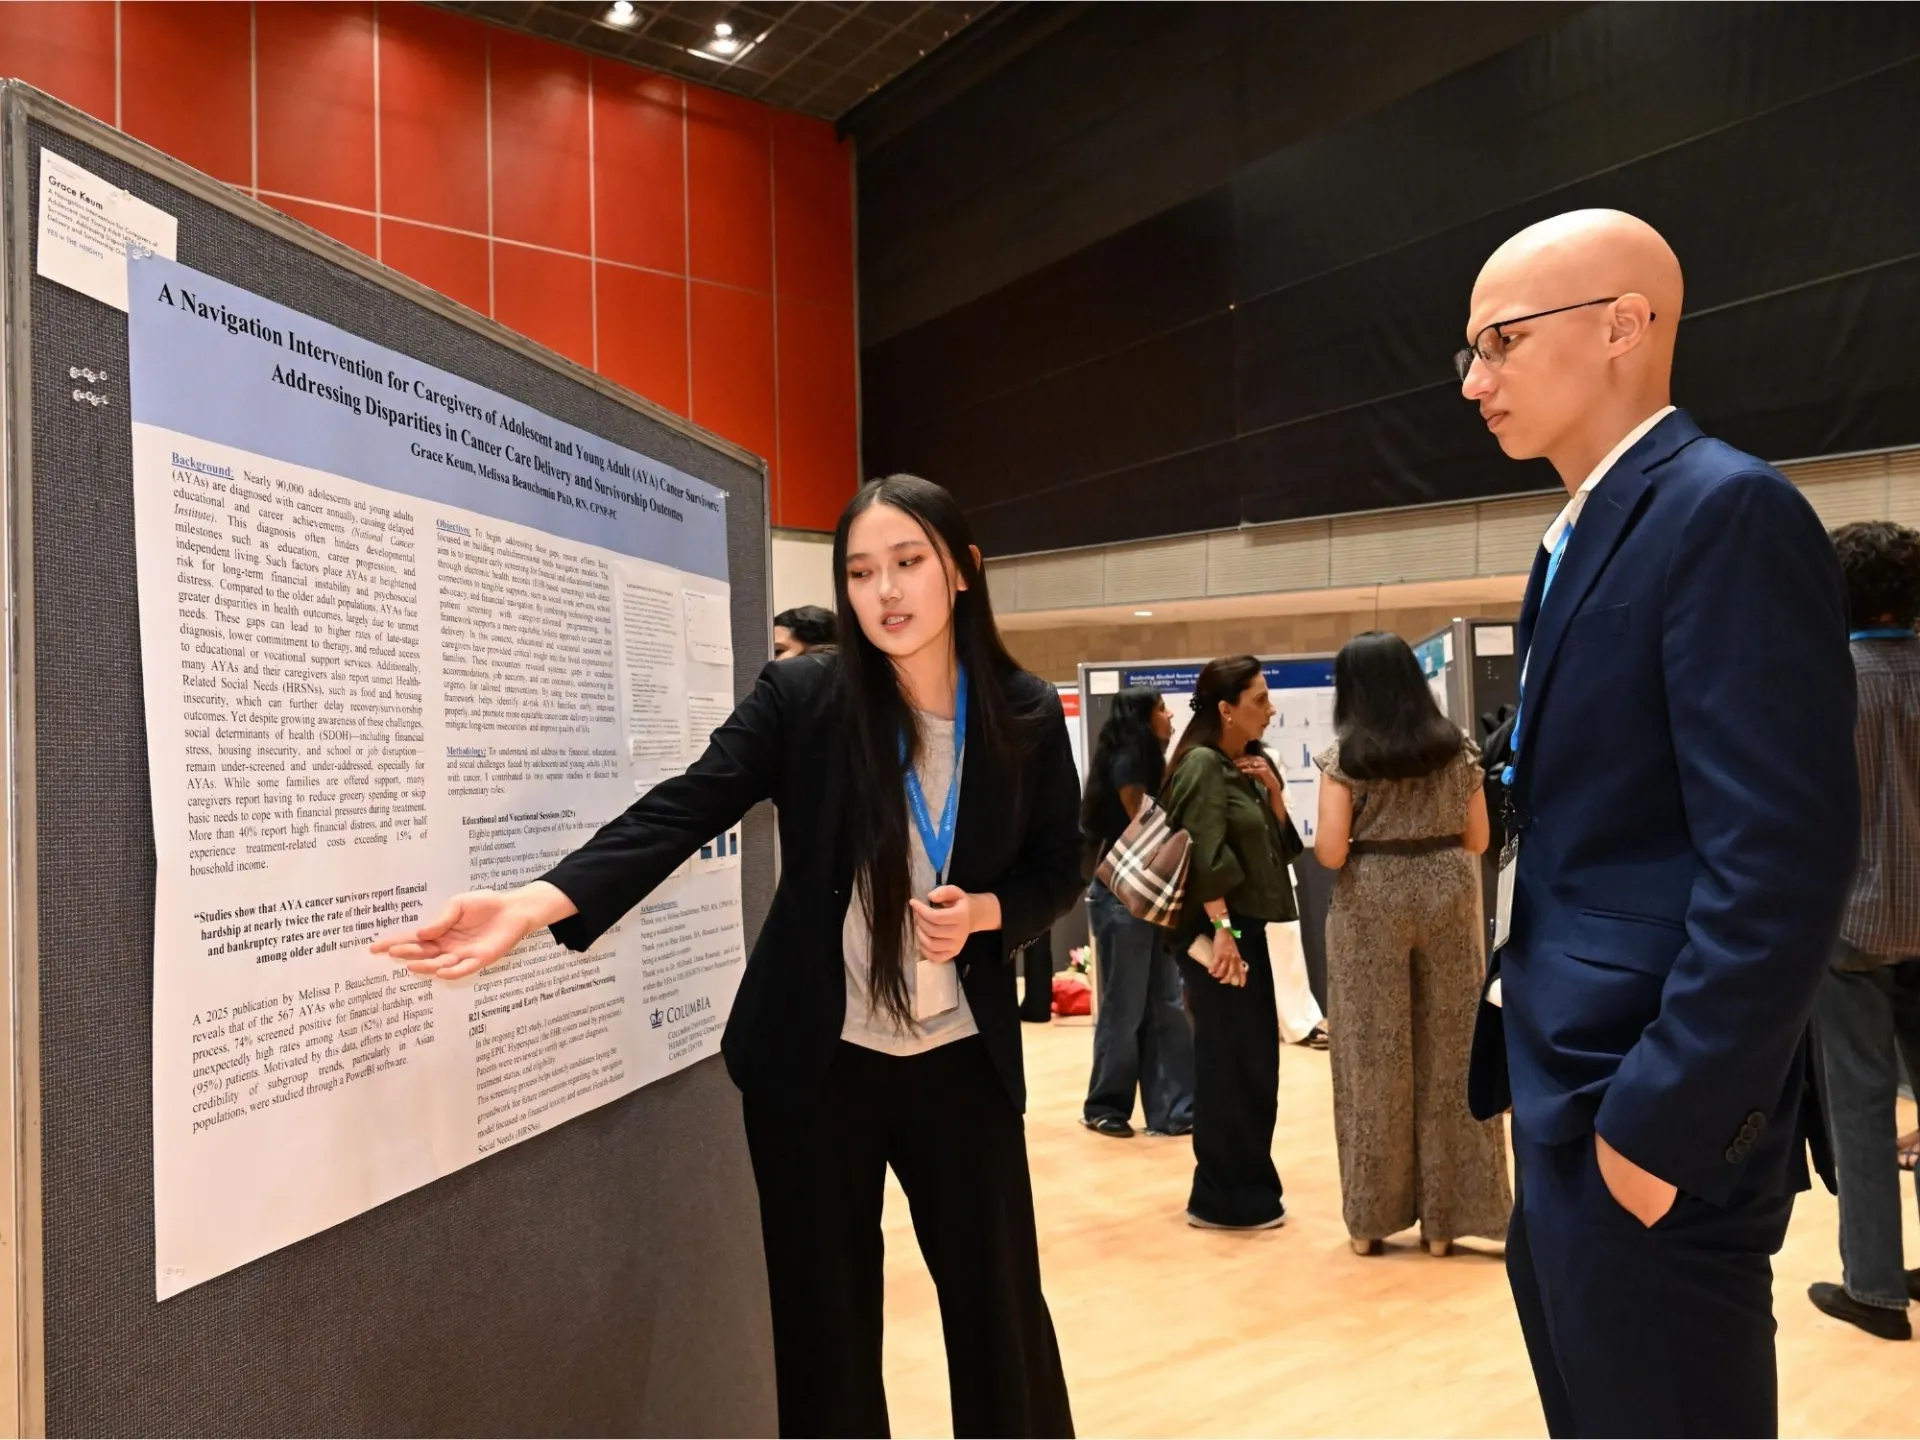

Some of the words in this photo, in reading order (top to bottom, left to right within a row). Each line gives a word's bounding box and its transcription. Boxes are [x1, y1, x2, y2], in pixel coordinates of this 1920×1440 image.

[49, 175, 76, 196] Grace
[80, 191, 103, 210] Keum
[47, 214, 70, 230] Delivery
[72, 227, 82, 236] and
[76, 220, 104, 239] Addressing
[80, 214, 89, 222] and
[91, 218, 106, 232] Young
[125, 226, 151, 245] Caregivers
[66, 236, 77, 248] THE
[79, 243, 104, 260] HEIGHTS
[158, 282, 175, 306] A
[180, 289, 282, 347] Navigation
[288, 331, 382, 384] Intervention
[388, 371, 409, 393] for
[414, 381, 482, 420] Caregivers
[486, 411, 496, 425] of
[500, 414, 552, 448] Adolescent
[555, 441, 572, 456] and
[576, 444, 604, 472] Young
[607, 460, 630, 478] Adult
[632, 469, 658, 488] (AYA)
[660, 478, 684, 498] Cancer
[686, 489, 719, 512] Survivors:
[272, 364, 361, 415] Addressing
[365, 395, 442, 437] Disparities
[445, 423, 457, 442] in
[462, 429, 501, 457] Cancer
[505, 444, 532, 468] Care
[534, 455, 571, 486] Delivery
[575, 473, 592, 489] and
[595, 478, 648, 512] Survivorship
[650, 499, 683, 522] Outcomes
[172, 452, 234, 479] Background:
[244, 470, 271, 489] Nearly
[276, 479, 304, 494] 90,000
[309, 488, 351, 506] adolescents
[354, 501, 366, 510] and
[369, 505, 390, 519] young
[393, 510, 414, 521] adults
[411, 442, 443, 463] Grace
[446, 452, 476, 476] Keum,
[478, 463, 510, 488] Melissa
[512, 476, 556, 501] Beauchemin
[557, 491, 573, 508] PhD,
[576, 498, 589, 511] RN,
[590, 502, 617, 520] CPNP-PC
[172, 470, 209, 490] (AYAs)
[213, 482, 226, 492] are
[230, 484, 272, 502] diagnosed
[275, 496, 294, 508] with
[297, 501, 323, 514] cancer
[327, 508, 358, 524] annually,
[361, 517, 385, 531] causing
[388, 522, 414, 536] delayed
[174, 488, 225, 508] educational
[235, 503, 250, 513] and
[259, 509, 284, 520] career
[292, 515, 345, 533] achievements
[351, 527, 383, 543] (National
[390, 536, 415, 549] Cancer
[446, 746, 486, 758] Methodology:
[462, 815, 496, 825] Educational
[498, 814, 508, 823] and
[510, 812, 538, 822] Vocational
[540, 811, 559, 819] Sessions
[190, 861, 234, 876] household
[236, 860, 268, 871] income.
[194, 909, 232, 923] “Studies
[235, 907, 255, 918] show
[258, 903, 276, 914] that
[280, 899, 302, 911] AYA
[306, 897, 333, 908] cancer
[336, 892, 369, 904] survivors
[371, 888, 393, 900] report
[396, 882, 427, 895] financial
[201, 924, 241, 941] hardship
[244, 924, 251, 933] at
[254, 918, 282, 931] nearly
[285, 915, 309, 926] twice
[312, 913, 324, 923] the
[327, 911, 343, 920] rate
[345, 907, 353, 917] of
[354, 905, 371, 916] their
[372, 901, 399, 913] healthy
[401, 900, 423, 912] peers,
[208, 944, 224, 956] and
[227, 937, 279, 952] bankruptcy
[281, 932, 304, 943] rates
[307, 931, 320, 940] are
[322, 927, 341, 936] over
[343, 924, 353, 933] ten
[356, 920, 374, 931] times
[376, 917, 399, 929] higher
[401, 914, 418, 923] than
[256, 951, 288, 964] among
[290, 946, 313, 958] older
[316, 942, 337, 953] adult
[192, 1014, 201, 1025] A
[206, 1007, 228, 1022] 2025
[232, 996, 278, 1019] publication
[282, 990, 294, 1006] by
[299, 986, 330, 1001] Melissa
[334, 983, 341, 993] P.
[345, 974, 389, 991] Beauchemin,
[392, 968, 410, 980] PhD,
[468, 1012, 480, 1022] R21
[481, 1004, 510, 1018] Screening
[512, 1001, 522, 1009] and
[524, 996, 538, 1006] Early
[540, 992, 554, 1002] Phase
[555, 988, 560, 996] of
[667, 996, 711, 1023] COLUMBIA
[469, 1024, 487, 1037] (2025)
[193, 1106, 247, 1134] populations,
[249, 1100, 270, 1112] were
[272, 1086, 304, 1104] studied
[306, 1077, 338, 1095] through
[345, 1065, 375, 1082] PowerBI
[377, 1056, 408, 1072] software.
[478, 1140, 496, 1154] Social
[496, 1132, 514, 1145] Needs
